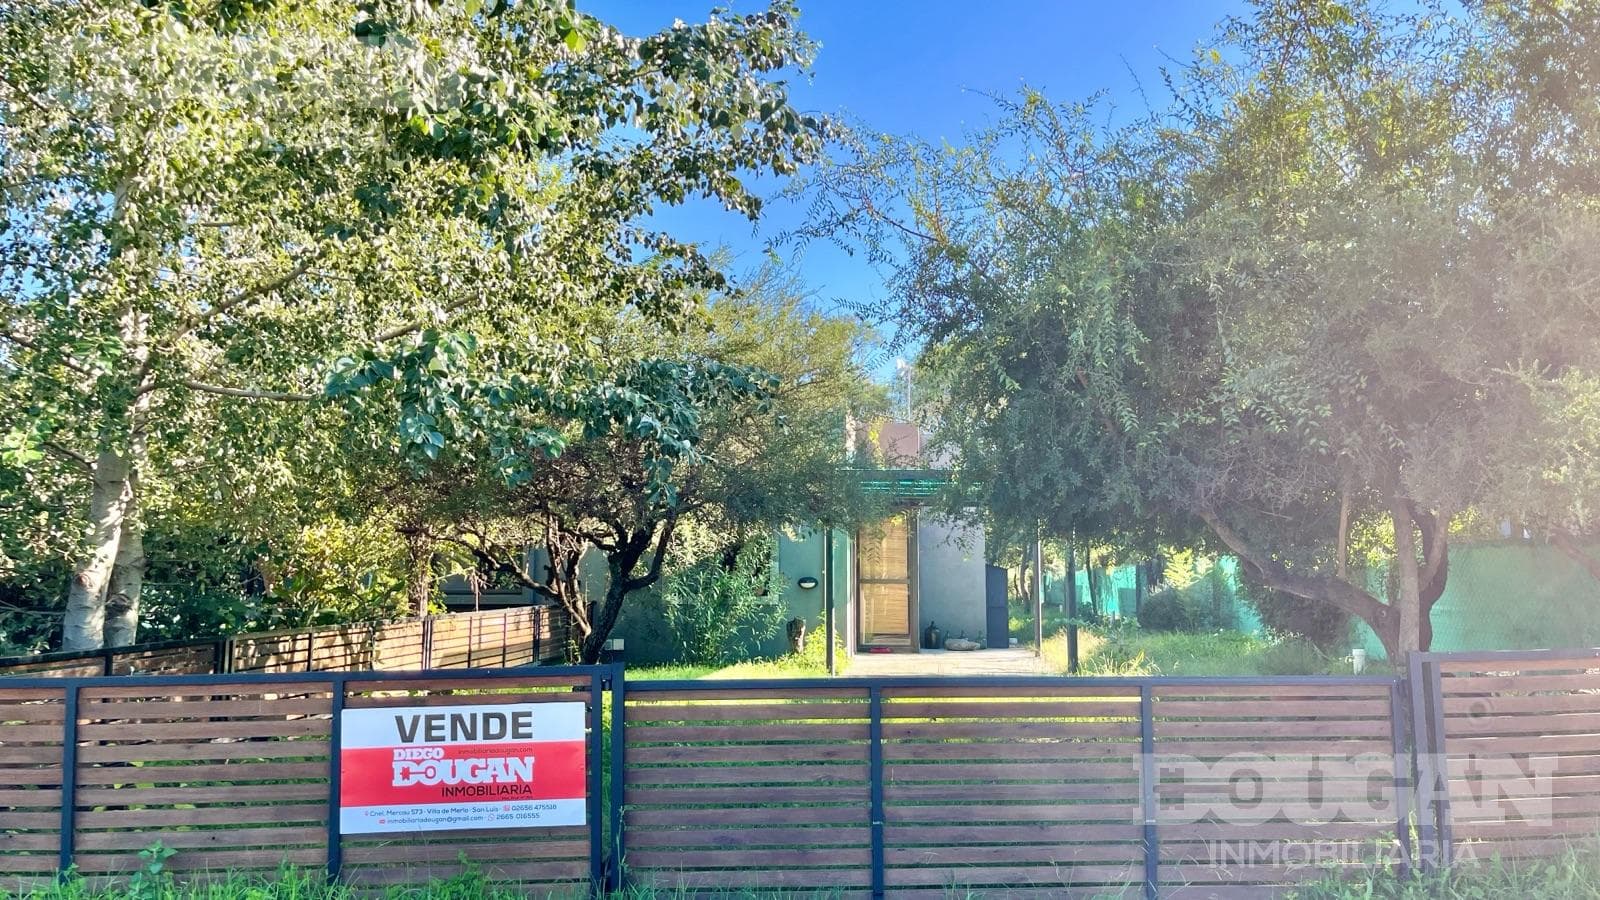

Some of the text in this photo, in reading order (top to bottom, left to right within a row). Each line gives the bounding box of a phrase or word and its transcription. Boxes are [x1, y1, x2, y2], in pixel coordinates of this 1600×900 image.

[395, 711, 534, 744] VENDE
[393, 747, 445, 761] DIEGO
[392, 756, 535, 787] DOUGAN
[441, 784, 533, 798] INMOBILIARIA
[485, 805, 499, 813] Luis
